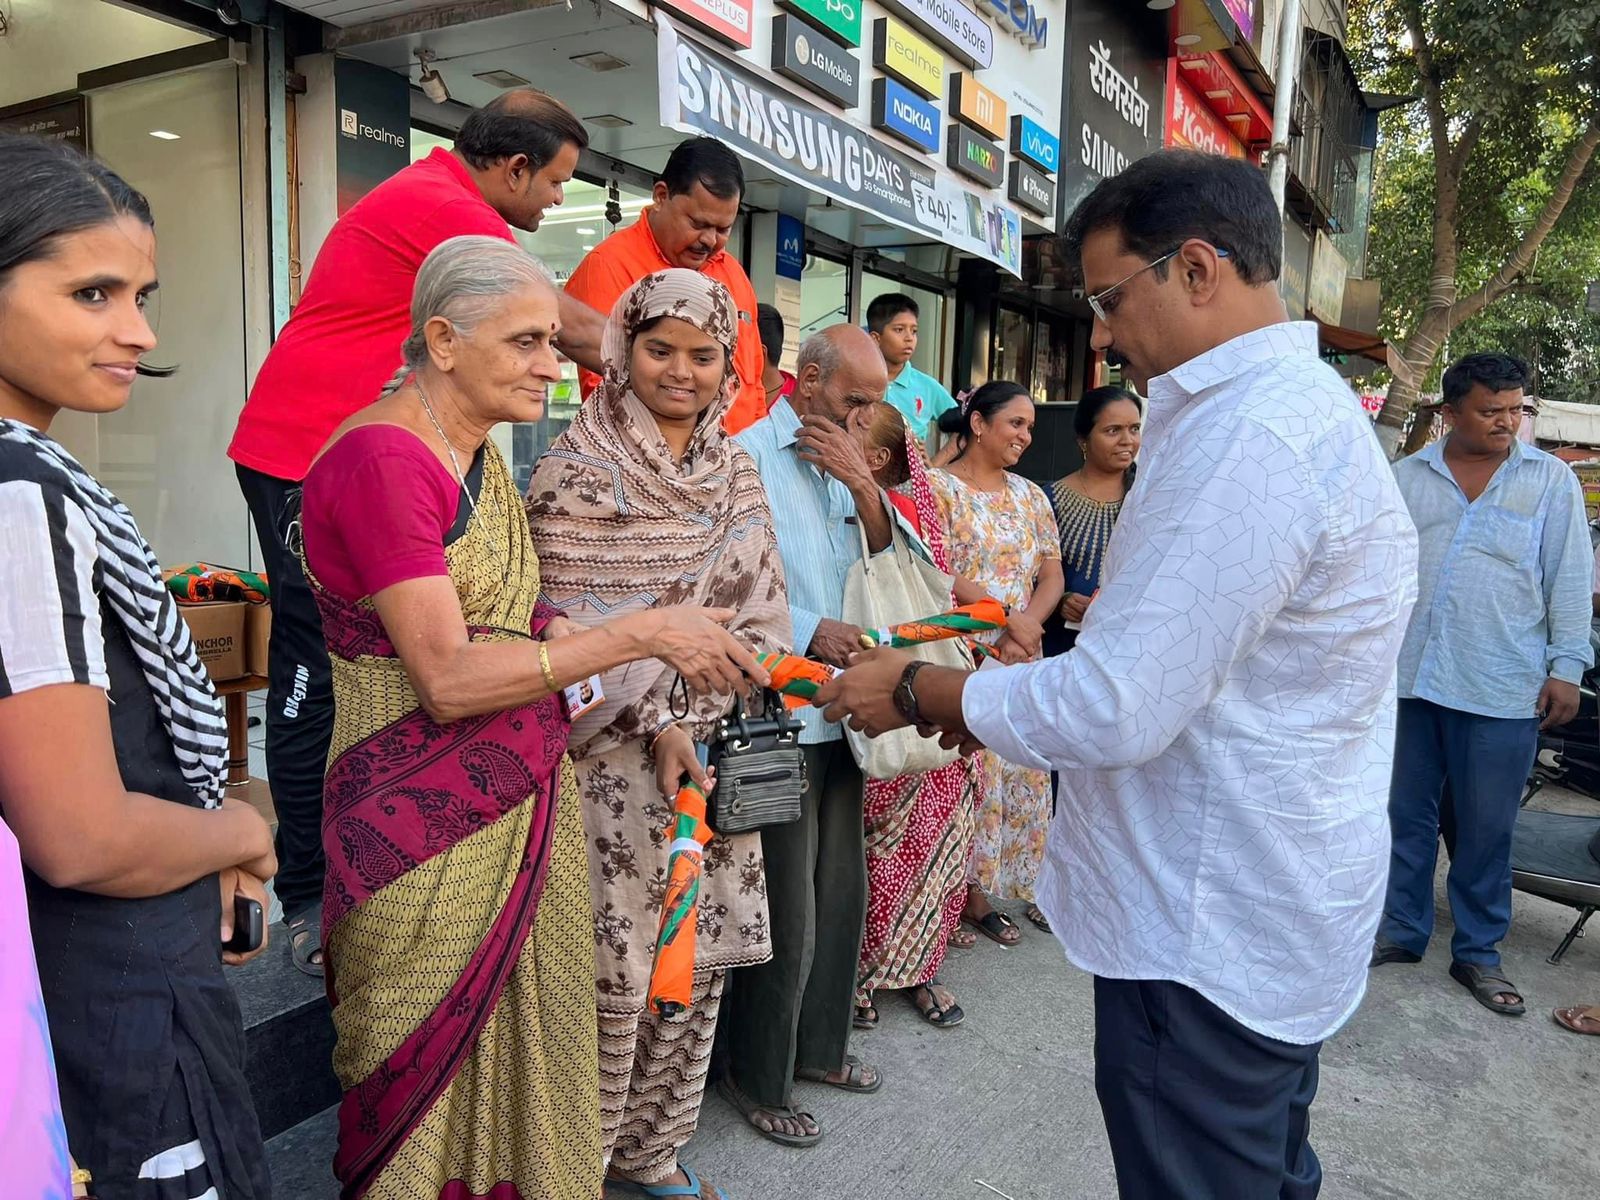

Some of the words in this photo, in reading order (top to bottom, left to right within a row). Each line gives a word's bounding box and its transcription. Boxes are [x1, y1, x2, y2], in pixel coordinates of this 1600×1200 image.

[926, 0, 960, 33] Mobile
[961, 22, 986, 54] Store
[888, 35, 941, 80] realme
[677, 43, 862, 192] SAMSUNG
[862, 147, 904, 192] DAYS
[893, 98, 933, 136] NOKIA
[359, 124, 405, 148] realme
[966, 140, 998, 174] NARZO
[863, 180, 873, 192] 5G
[872, 183, 912, 209] Smartphones
[1028, 176, 1050, 206] iPhone
[194, 636, 233, 649] NCHOR
